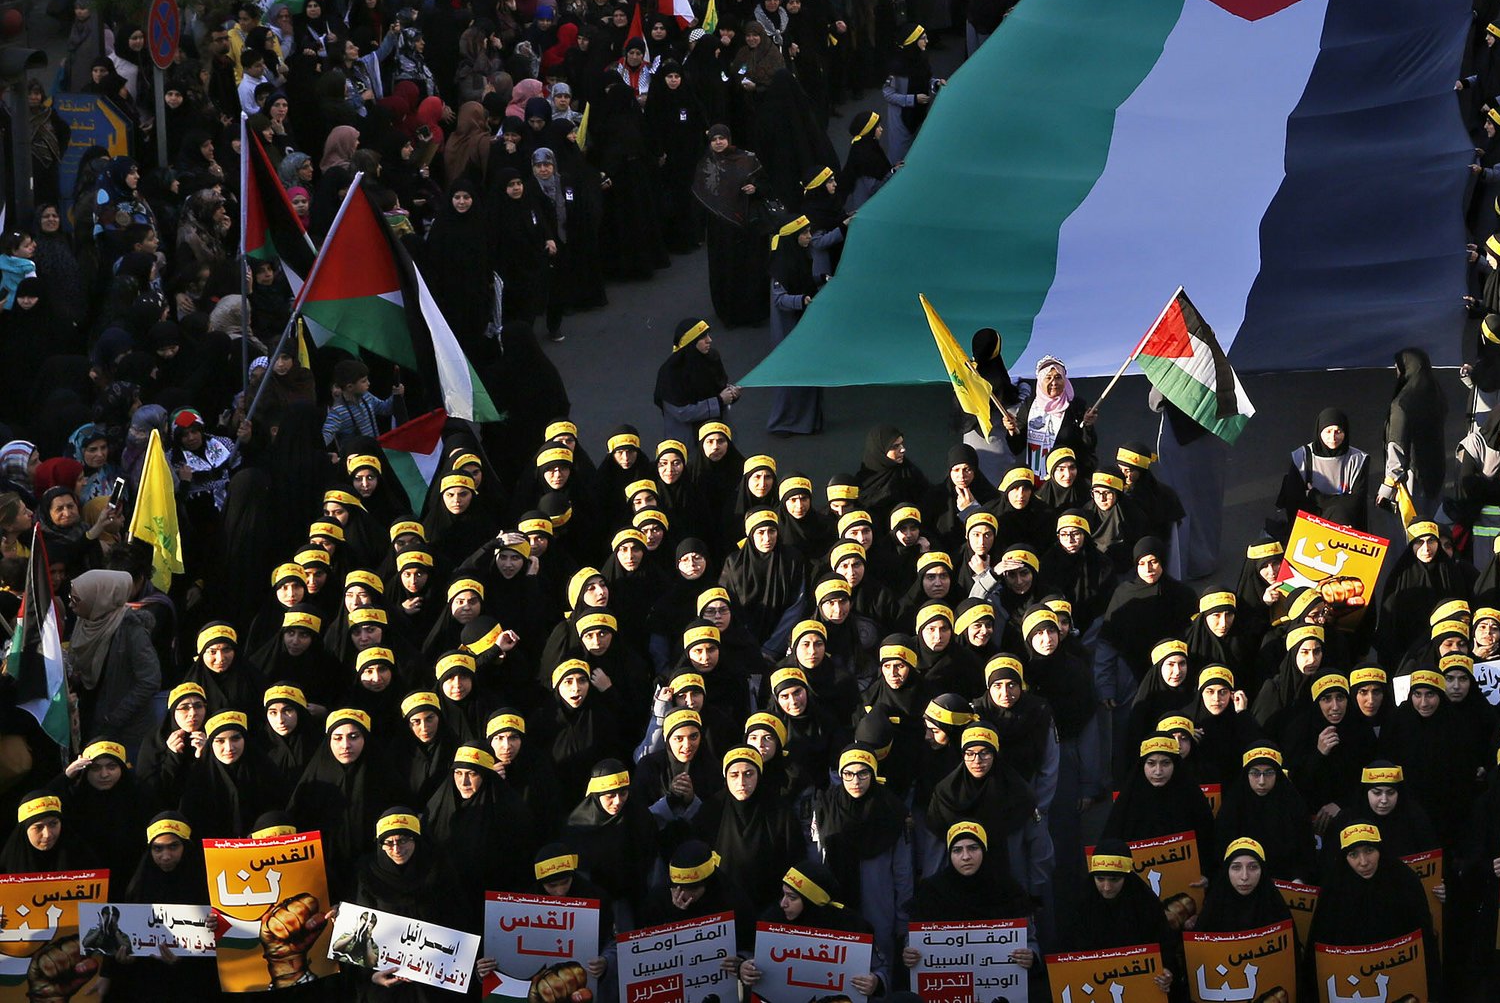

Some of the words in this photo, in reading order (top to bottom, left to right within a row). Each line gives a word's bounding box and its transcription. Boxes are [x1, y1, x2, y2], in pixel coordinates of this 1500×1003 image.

[1292, 536, 1349, 576] لنا
[1327, 538, 1381, 558] القدس
[250, 844, 315, 872] القدس
[1132, 845, 1191, 874] القدس
[32, 883, 101, 908] القدس
[216, 867, 283, 906] لنا
[499, 910, 575, 931] القدس
[131, 934, 161, 949] القوة
[516, 935, 574, 958] لنا
[631, 923, 727, 954] المقاومة
[923, 930, 1018, 947] المقاومة
[1228, 934, 1288, 966] القدس
[379, 945, 406, 968] القوة
[406, 957, 424, 974] لغة
[632, 954, 683, 977] السبيل
[688, 948, 728, 966] هي
[770, 944, 847, 964] القدس
[924, 953, 974, 969] السبيل
[1360, 945, 1419, 977] القدس
[434, 967, 459, 985] تعرف
[458, 972, 468, 988] لا
[684, 969, 728, 988] الوحيد
[787, 966, 844, 992] لنا
[975, 974, 1019, 989] الوحيد
[1093, 956, 1156, 984] القدس
[633, 976, 680, 1002] لتحرير
[924, 974, 970, 991] لتحرير
[1195, 962, 1259, 1002] لنا
